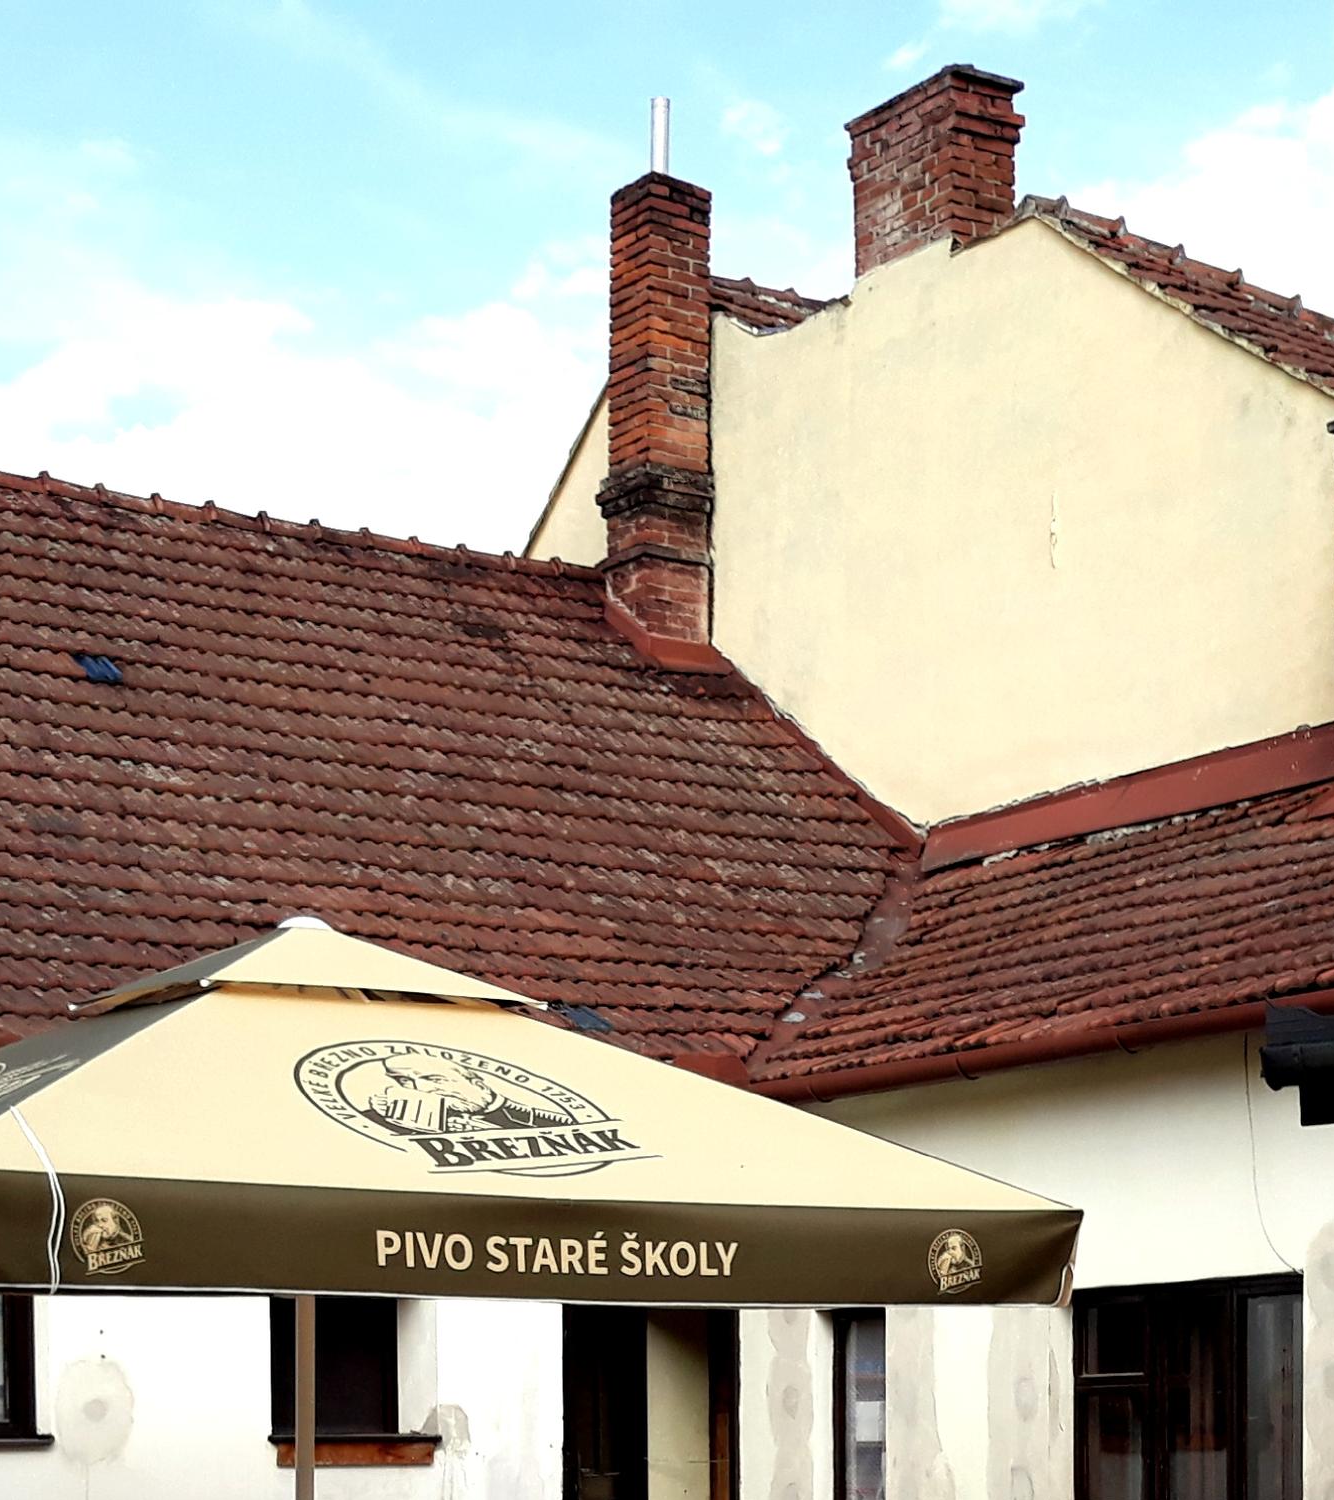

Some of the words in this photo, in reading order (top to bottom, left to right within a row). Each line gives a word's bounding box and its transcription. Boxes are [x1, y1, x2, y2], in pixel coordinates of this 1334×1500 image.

[307, 1046, 377, 1080] BŘEZNO
[303, 1079, 357, 1120] VELKÉ
[541, 1086, 587, 1111] 1753
[408, 1128, 641, 1168] BŘEZŇÁK
[376, 1229, 474, 1271] PIVO
[485, 1231, 610, 1276] STARÉ
[620, 1231, 739, 1277] ŠKOLY
